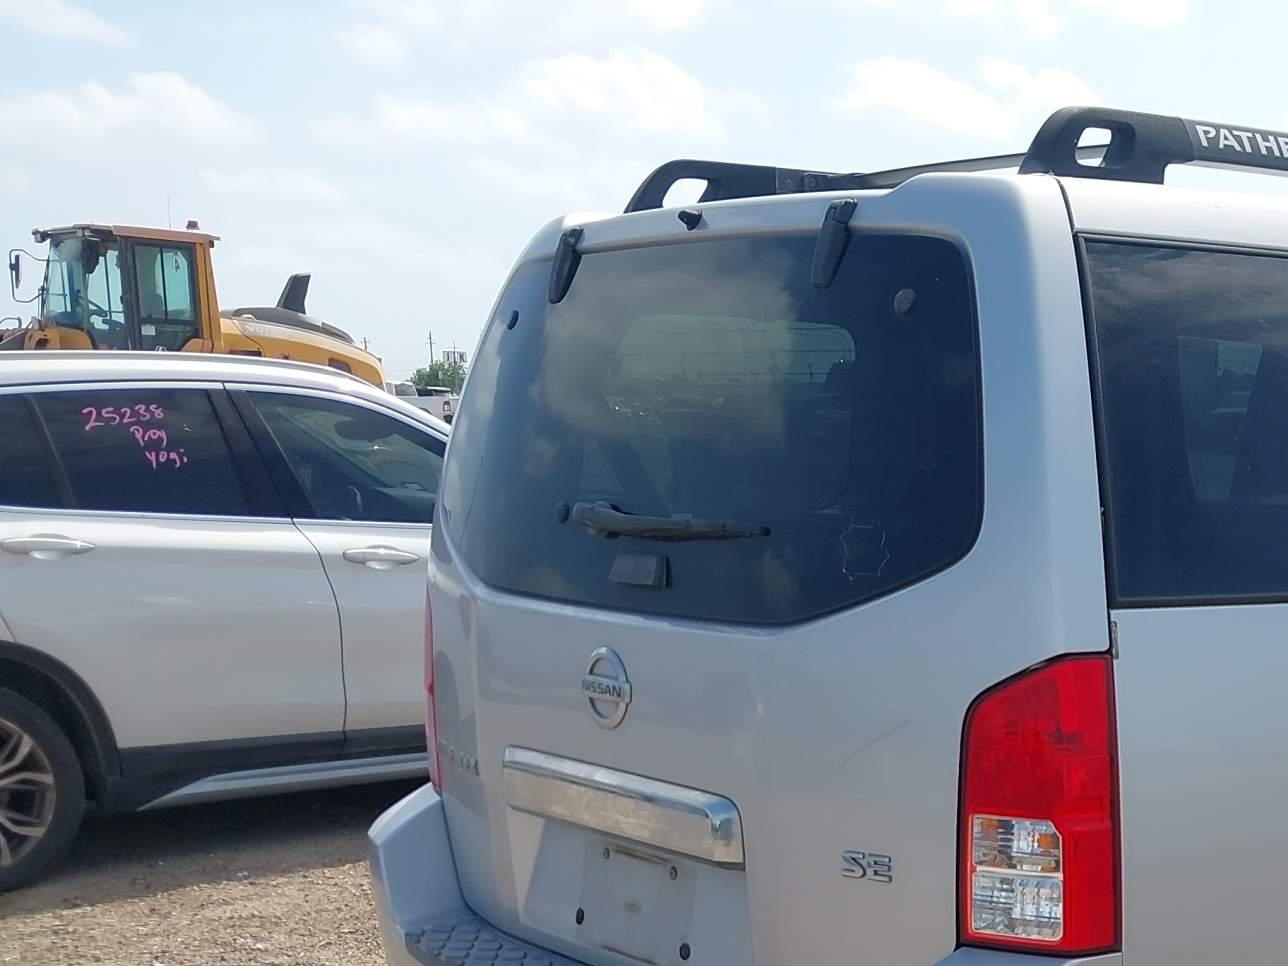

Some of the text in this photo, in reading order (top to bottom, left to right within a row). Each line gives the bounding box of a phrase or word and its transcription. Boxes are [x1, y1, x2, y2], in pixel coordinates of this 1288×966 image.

[81, 403, 164, 432] 25238
[582, 677, 622, 698] NISSAN
[841, 849, 893, 884] SE
